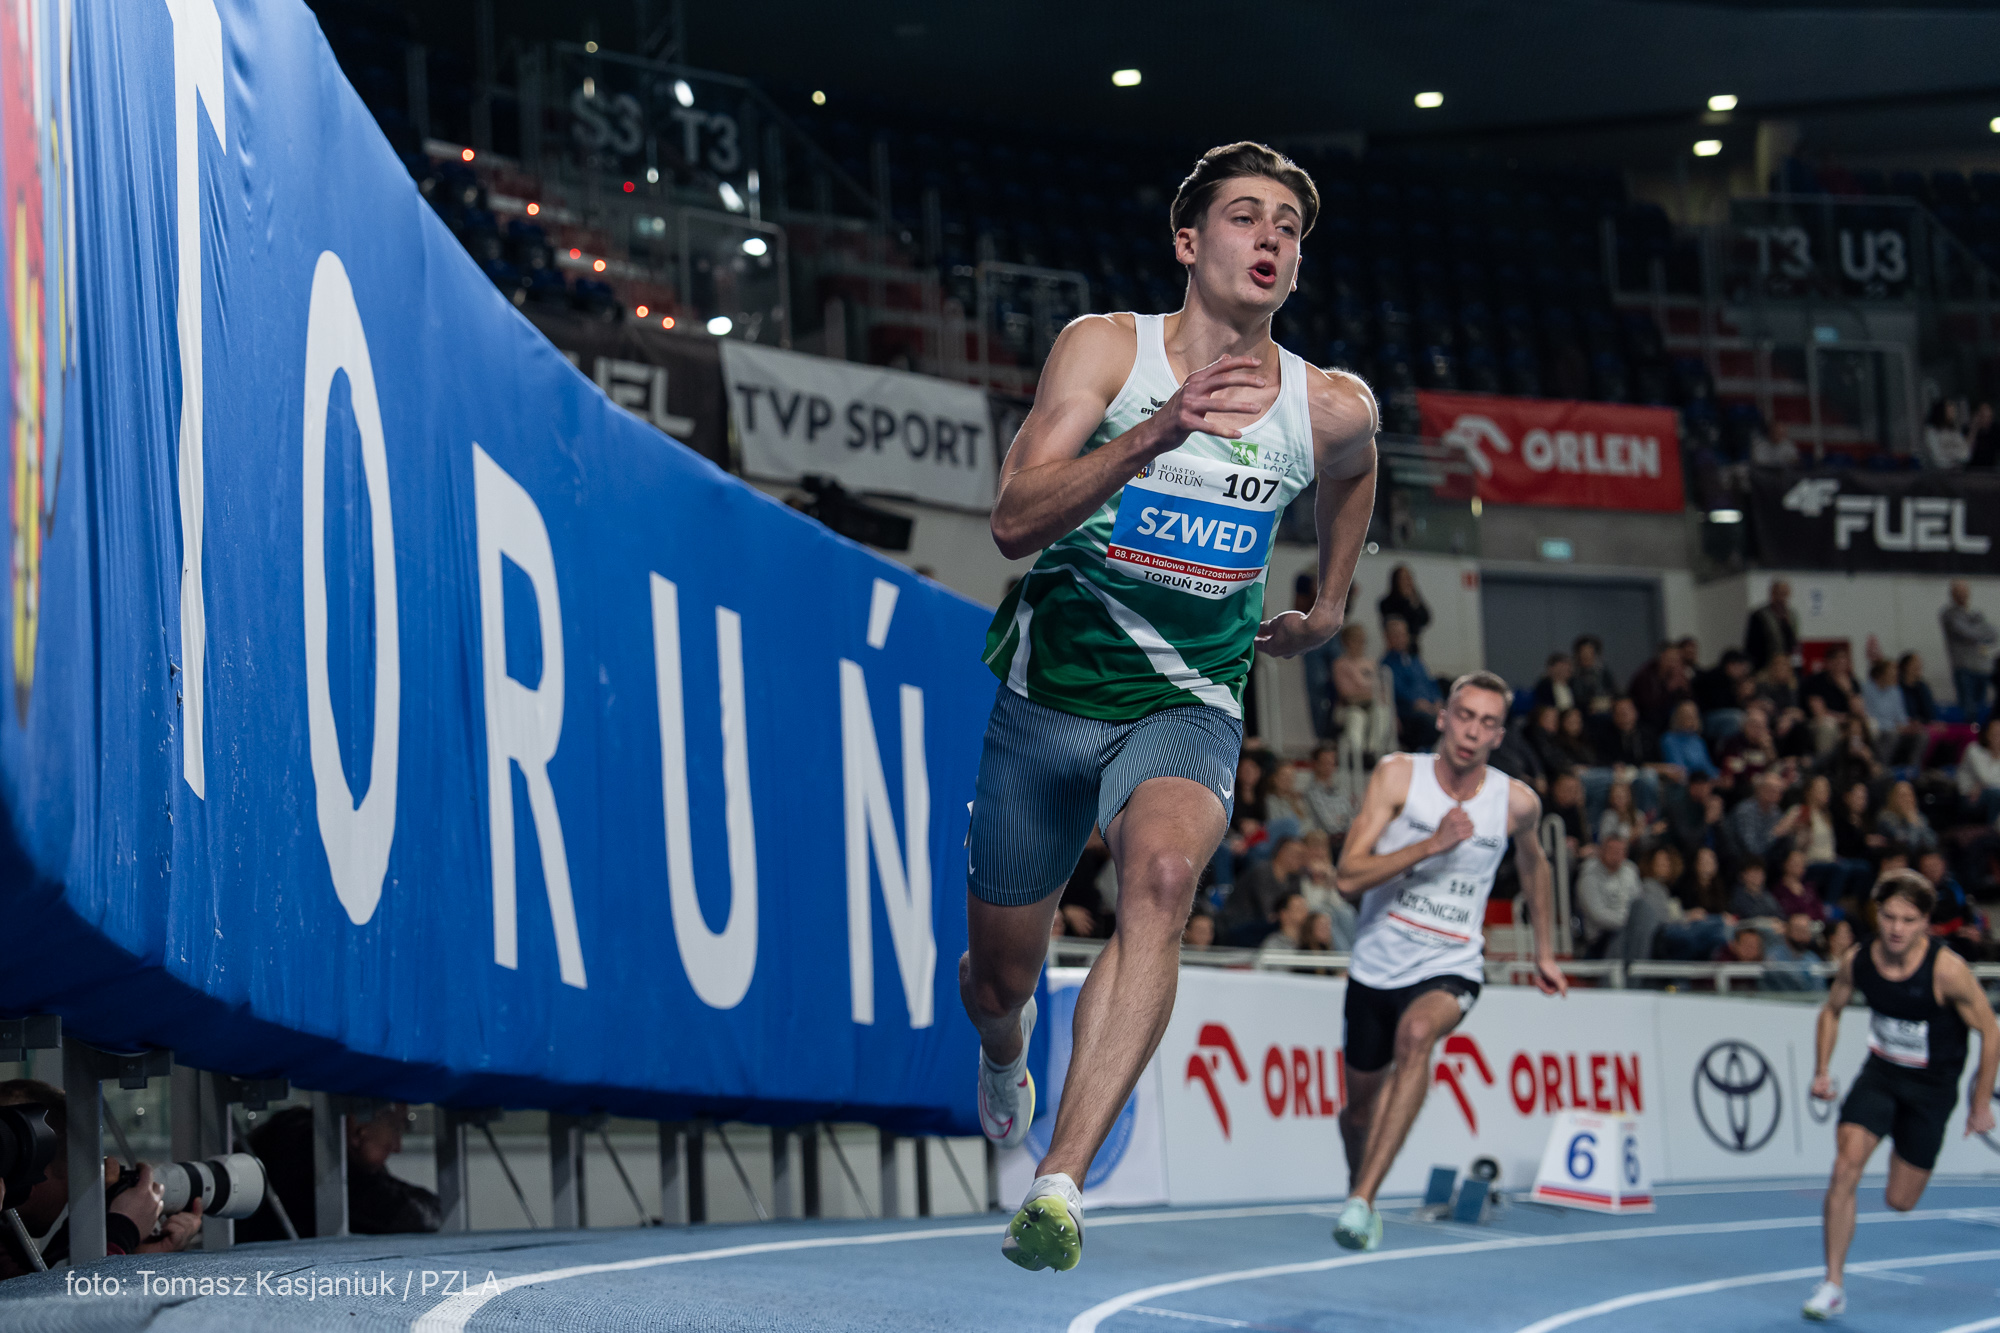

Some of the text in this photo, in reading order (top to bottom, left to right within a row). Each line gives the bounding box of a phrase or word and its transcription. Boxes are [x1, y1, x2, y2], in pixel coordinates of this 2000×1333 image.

[670, 107, 740, 172] T3
[1839, 228, 1907, 281] U3
[735, 383, 983, 468] TVP SPORT
[1158, 469, 1204, 487] TORUŃ
[1161, 464, 1196, 476] MIASTO
[1264, 451, 1288, 464] AZS
[1522, 428, 1661, 478] ORLEN
[1222, 473, 1280, 504] 107
[164, 0, 936, 1028] TORUŃ
[1136, 507, 1258, 554] SZWED
[1834, 494, 1991, 554] FUEL
[1114, 549, 1128, 560] 68.
[1130, 552, 1150, 565] PZLA
[1152, 558, 1185, 571] Halowe
[1186, 565, 1237, 580] Mistrzostwa
[1143, 570, 1228, 596] TORUŃ 2024
[1262, 1044, 1347, 1118] ORL
[1510, 1052, 1643, 1117] ORLEN
[1565, 1131, 1597, 1181] 6
[1622, 1134, 1641, 1186] 6
